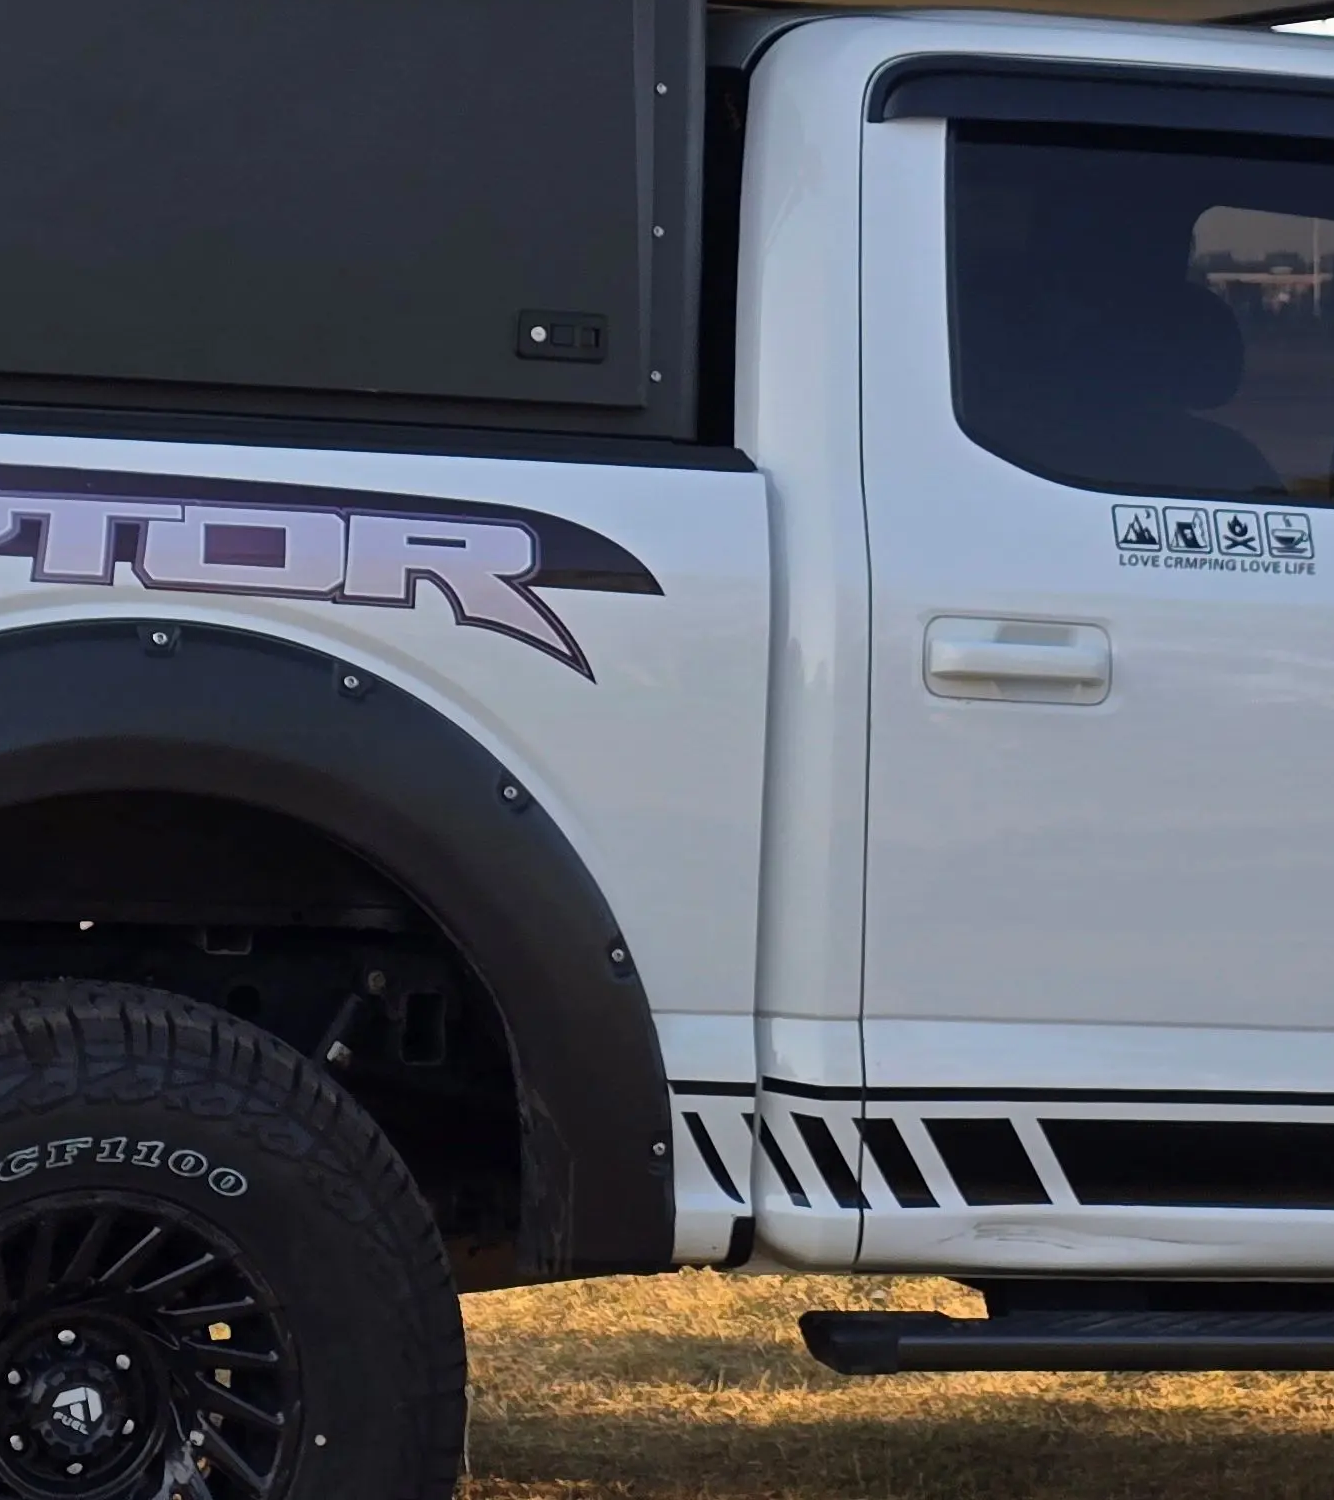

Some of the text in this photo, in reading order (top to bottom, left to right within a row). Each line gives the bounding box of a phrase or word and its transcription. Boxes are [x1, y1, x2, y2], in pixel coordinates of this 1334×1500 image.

[1118, 553, 1160, 568] LOVE
[1240, 559, 1282, 575] LOVE
[1284, 561, 1316, 576] LIFE
